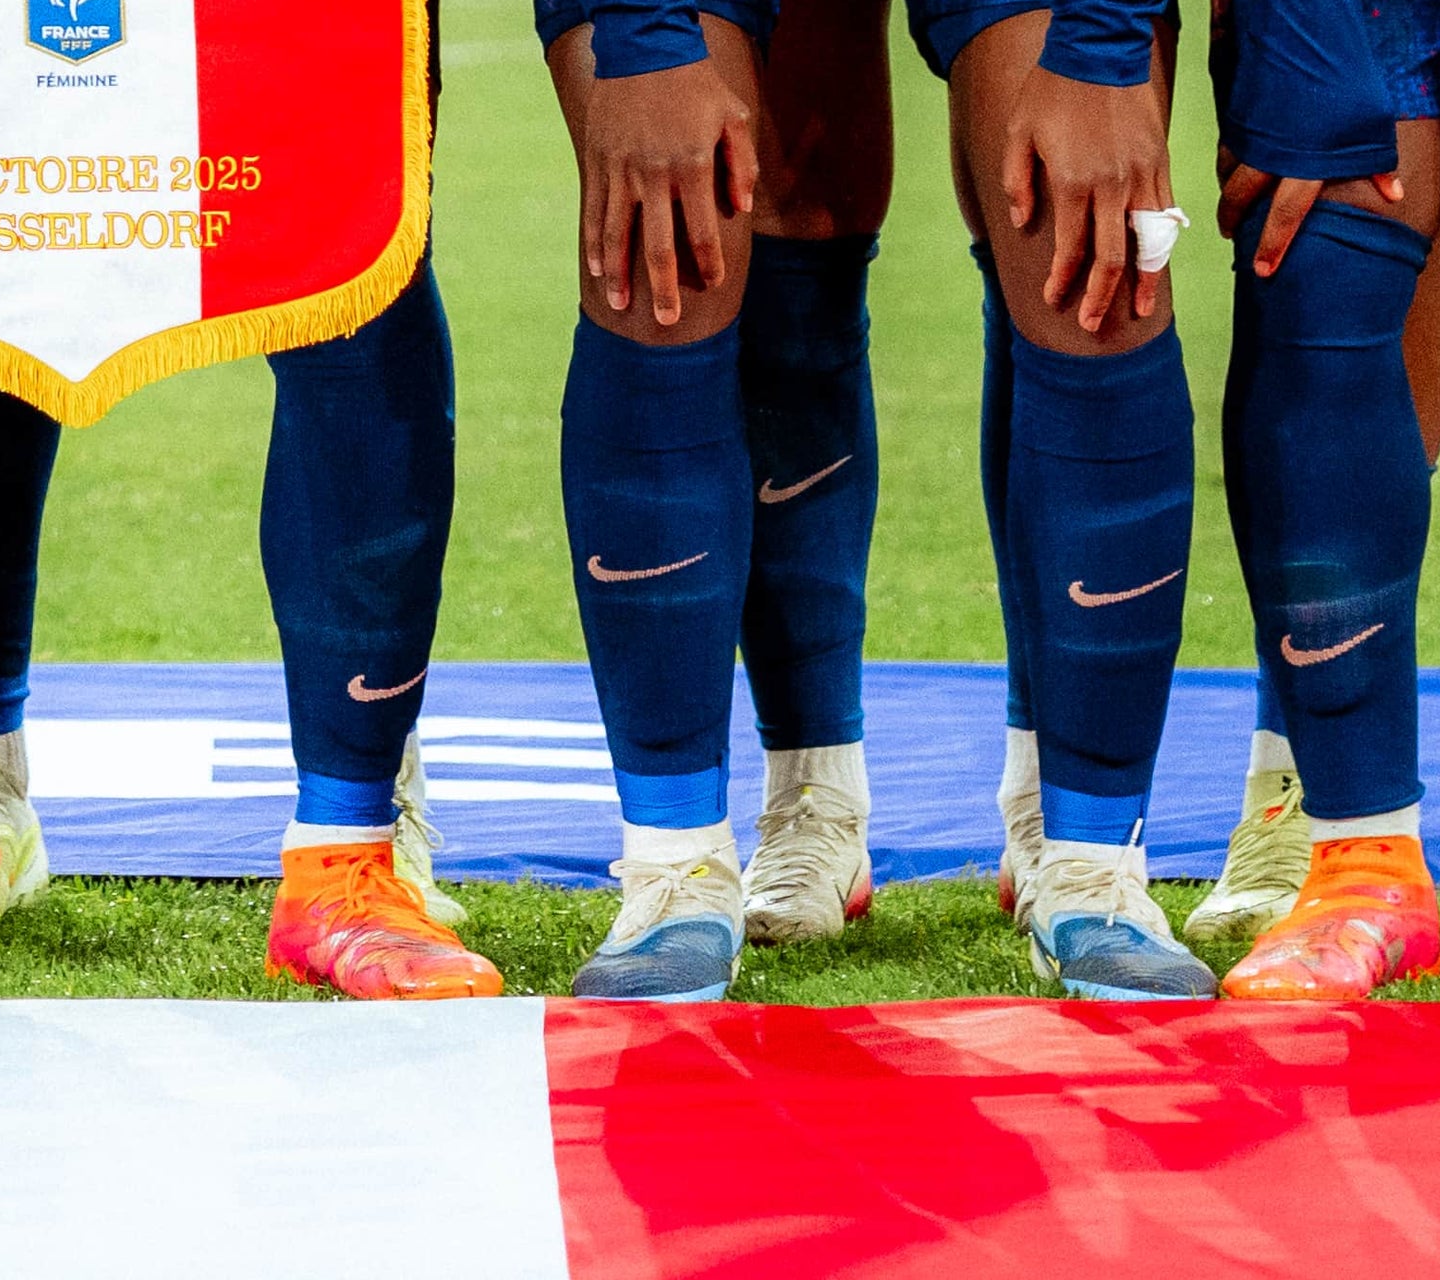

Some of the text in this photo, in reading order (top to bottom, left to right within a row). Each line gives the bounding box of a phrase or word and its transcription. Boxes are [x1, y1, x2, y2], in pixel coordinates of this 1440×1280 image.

[41, 25, 110, 40] FRANCE
[60, 40, 92, 52] FFF
[37, 72, 118, 88] FÉMININE
[170, 155, 263, 192] 2025
